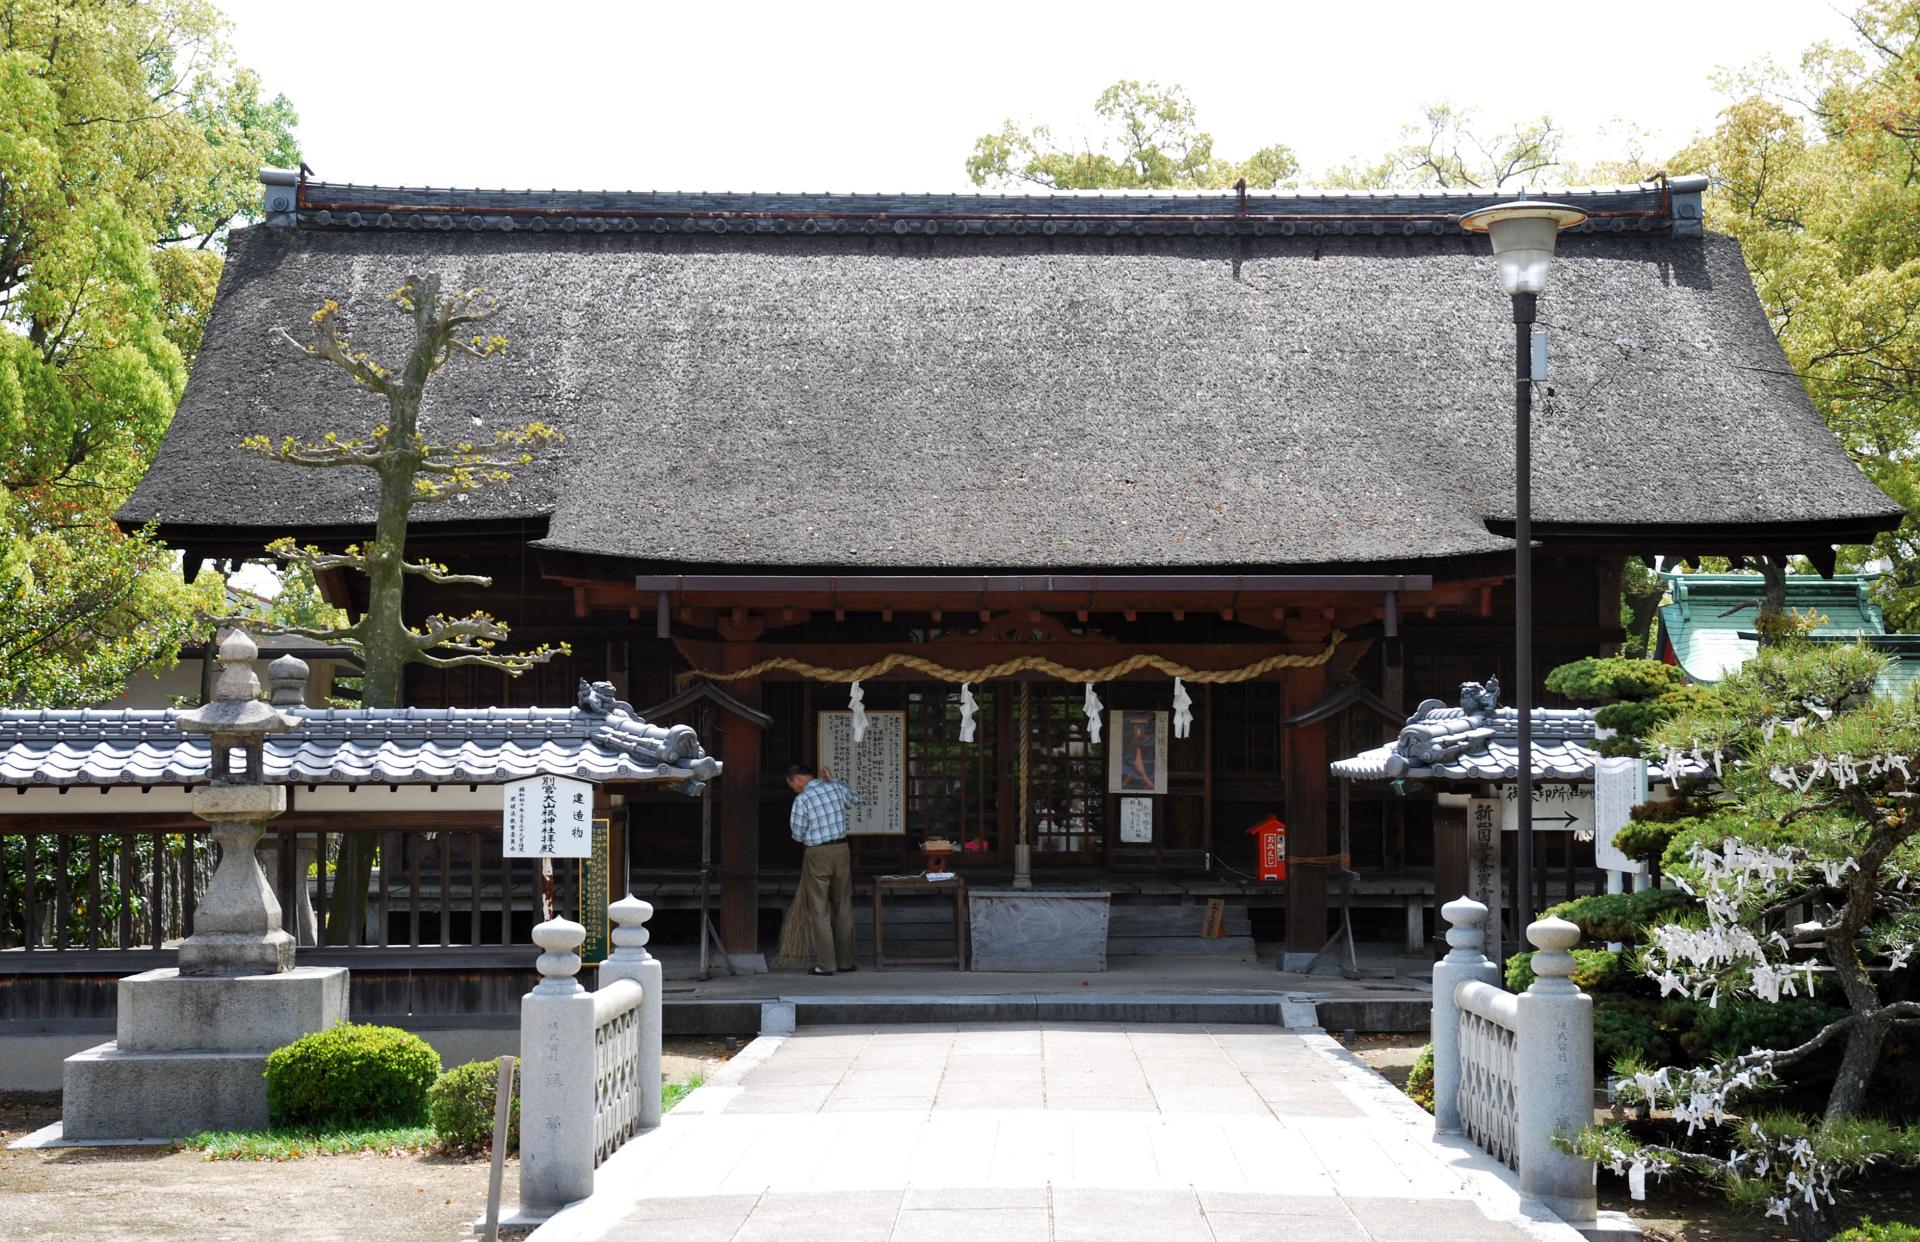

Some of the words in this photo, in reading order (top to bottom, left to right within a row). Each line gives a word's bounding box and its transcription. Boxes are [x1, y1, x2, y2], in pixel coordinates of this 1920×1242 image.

[571, 792, 585, 839] 建造物
[1266, 835, 1276, 866] おみくじ
